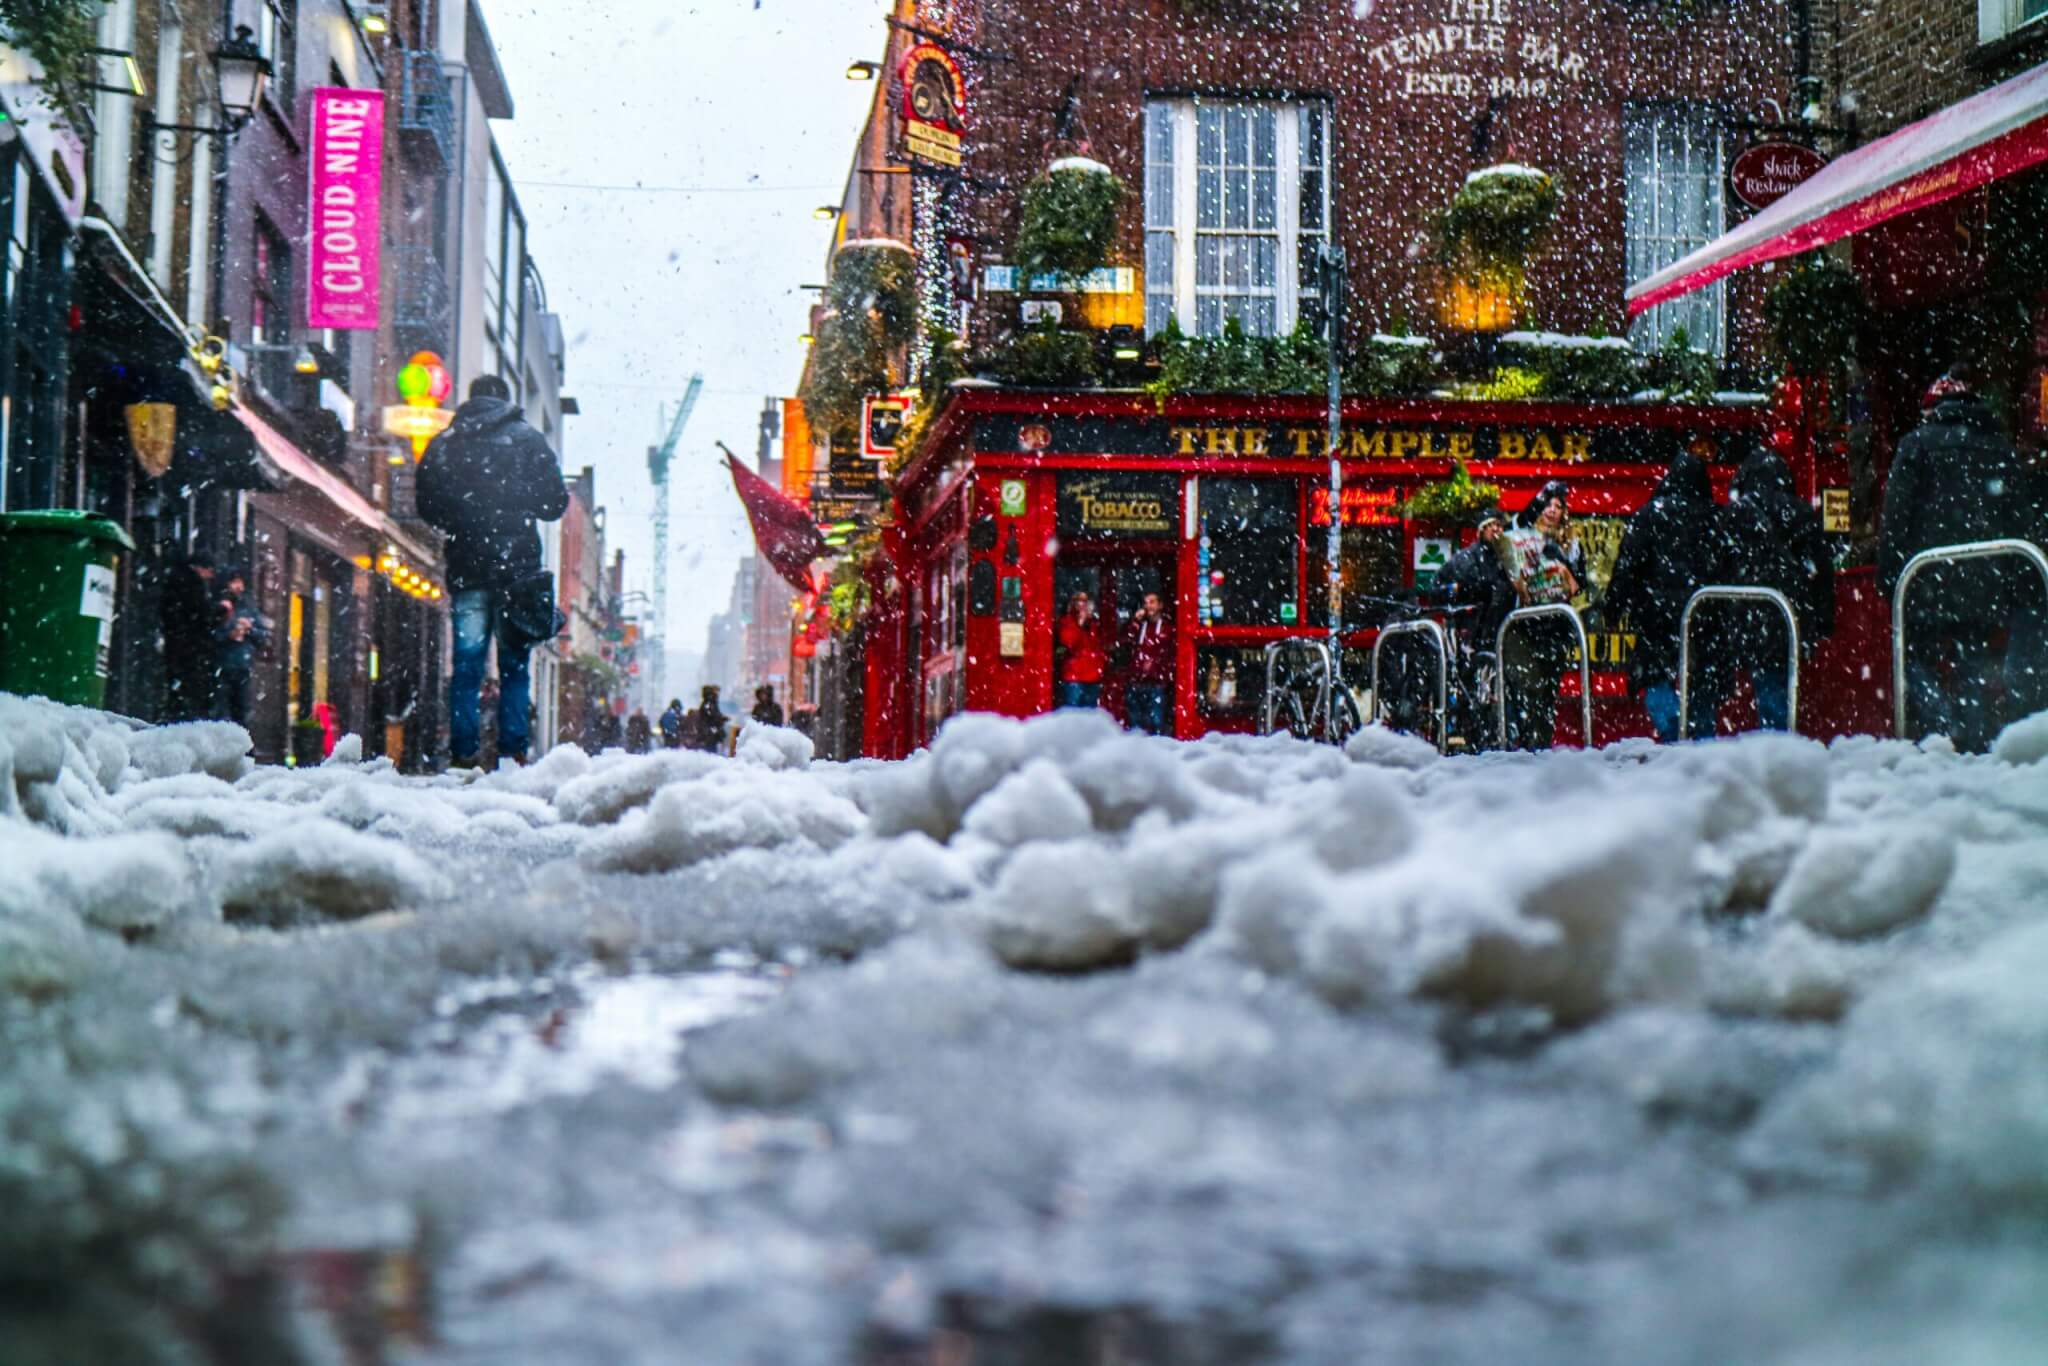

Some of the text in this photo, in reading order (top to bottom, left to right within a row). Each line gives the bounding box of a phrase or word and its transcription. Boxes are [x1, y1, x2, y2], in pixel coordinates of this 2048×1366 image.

[1450, 0, 1511, 22] THE
[1369, 24, 1585, 81] TEMPLE BAR
[325, 98, 369, 173] NINE
[322, 184, 364, 293] CLOUD
[1171, 427, 1590, 460] THE TEMPLE BAR
